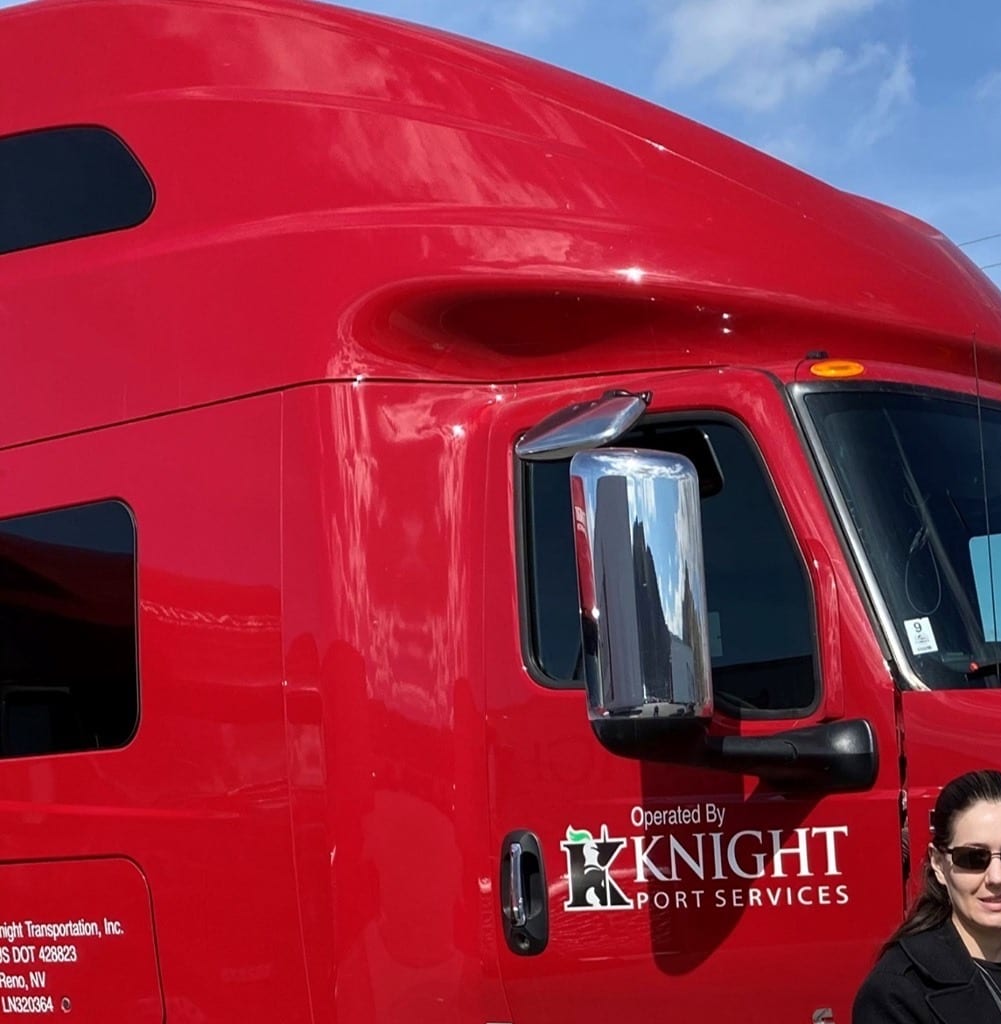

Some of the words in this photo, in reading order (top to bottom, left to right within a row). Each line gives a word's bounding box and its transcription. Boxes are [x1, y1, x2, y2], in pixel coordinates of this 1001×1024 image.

[631, 804, 700, 830] Operated
[706, 803, 725, 827] By
[630, 826, 848, 883] KNIGHT
[637, 891, 704, 910] PORT
[715, 885, 849, 908] SERVICES
[0, 921, 23, 942] night
[25, 919, 101, 941] Transportation,
[104, 918, 124, 935] Inc.
[12, 946, 35, 963] DOT
[39, 946, 77, 962] 428823
[0, 972, 28, 991] Reno,
[29, 971, 46, 988] NV
